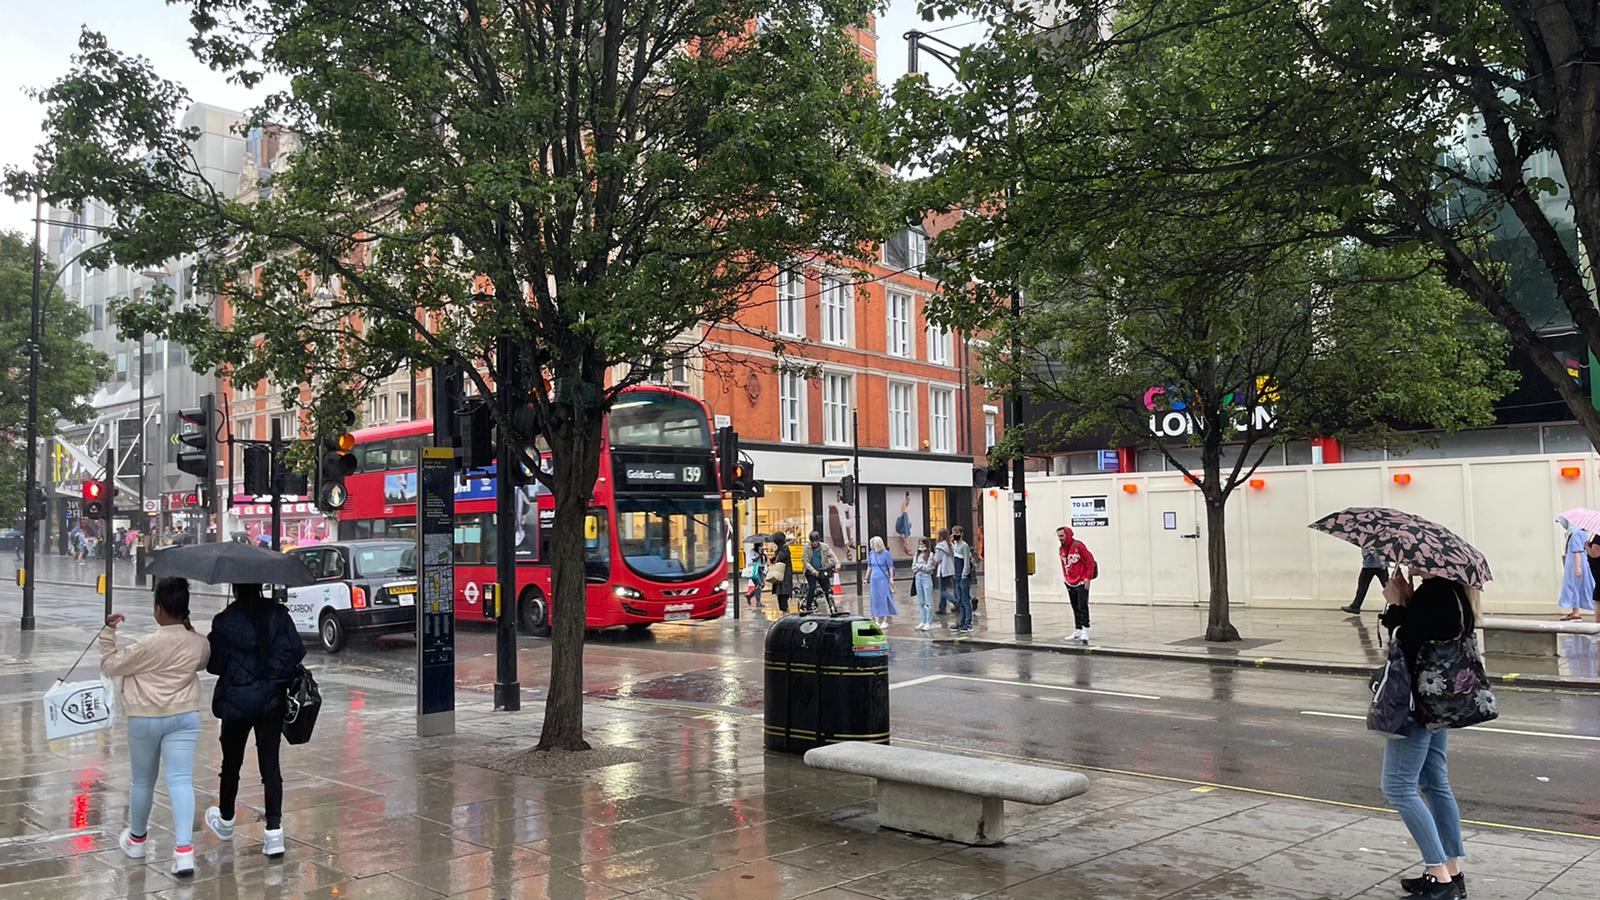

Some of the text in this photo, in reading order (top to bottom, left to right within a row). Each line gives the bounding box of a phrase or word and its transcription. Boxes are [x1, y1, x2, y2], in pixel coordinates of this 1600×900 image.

[1149, 405, 1278, 437] LONON
[626, 466, 702, 482] Golders Green 139
[84, 692, 95, 720] KING
